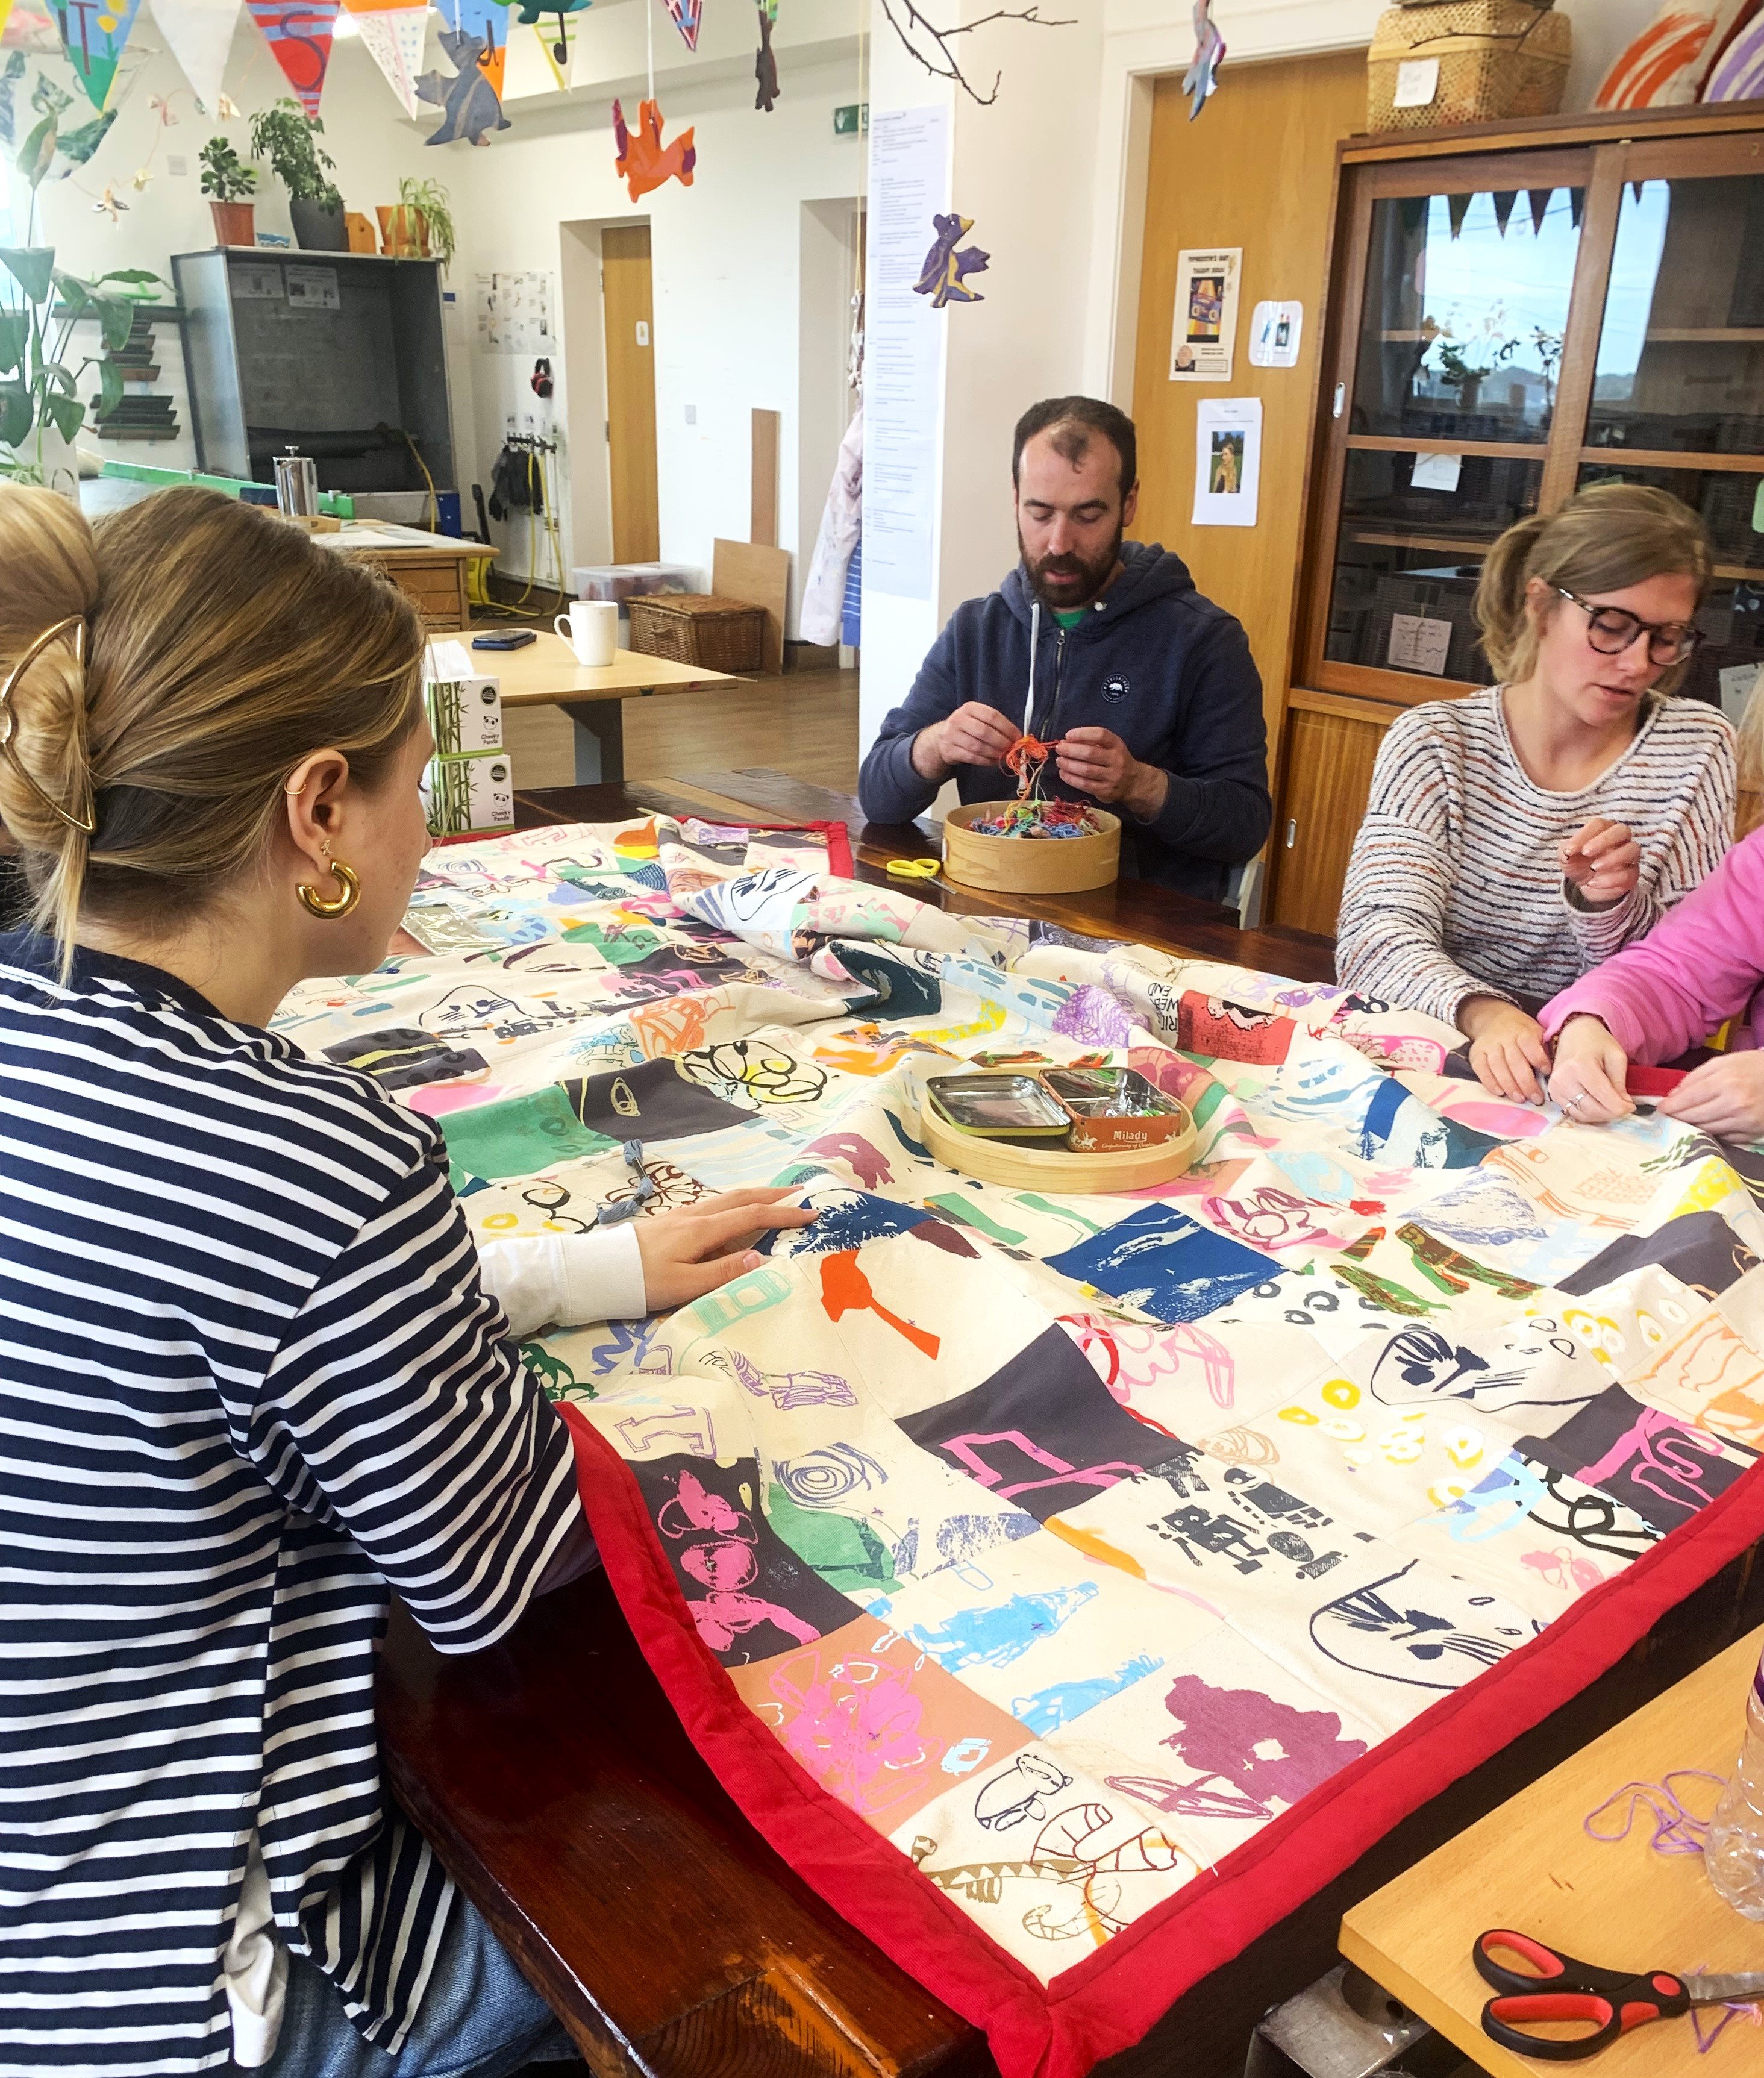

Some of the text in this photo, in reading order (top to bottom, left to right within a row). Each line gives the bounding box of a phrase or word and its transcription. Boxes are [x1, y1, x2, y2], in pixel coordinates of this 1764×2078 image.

[69, 1, 99, 75] T
[280, 11, 328, 90] S
[1148, 983, 1173, 997] END
[1113, 1130, 1148, 1141] Milady
